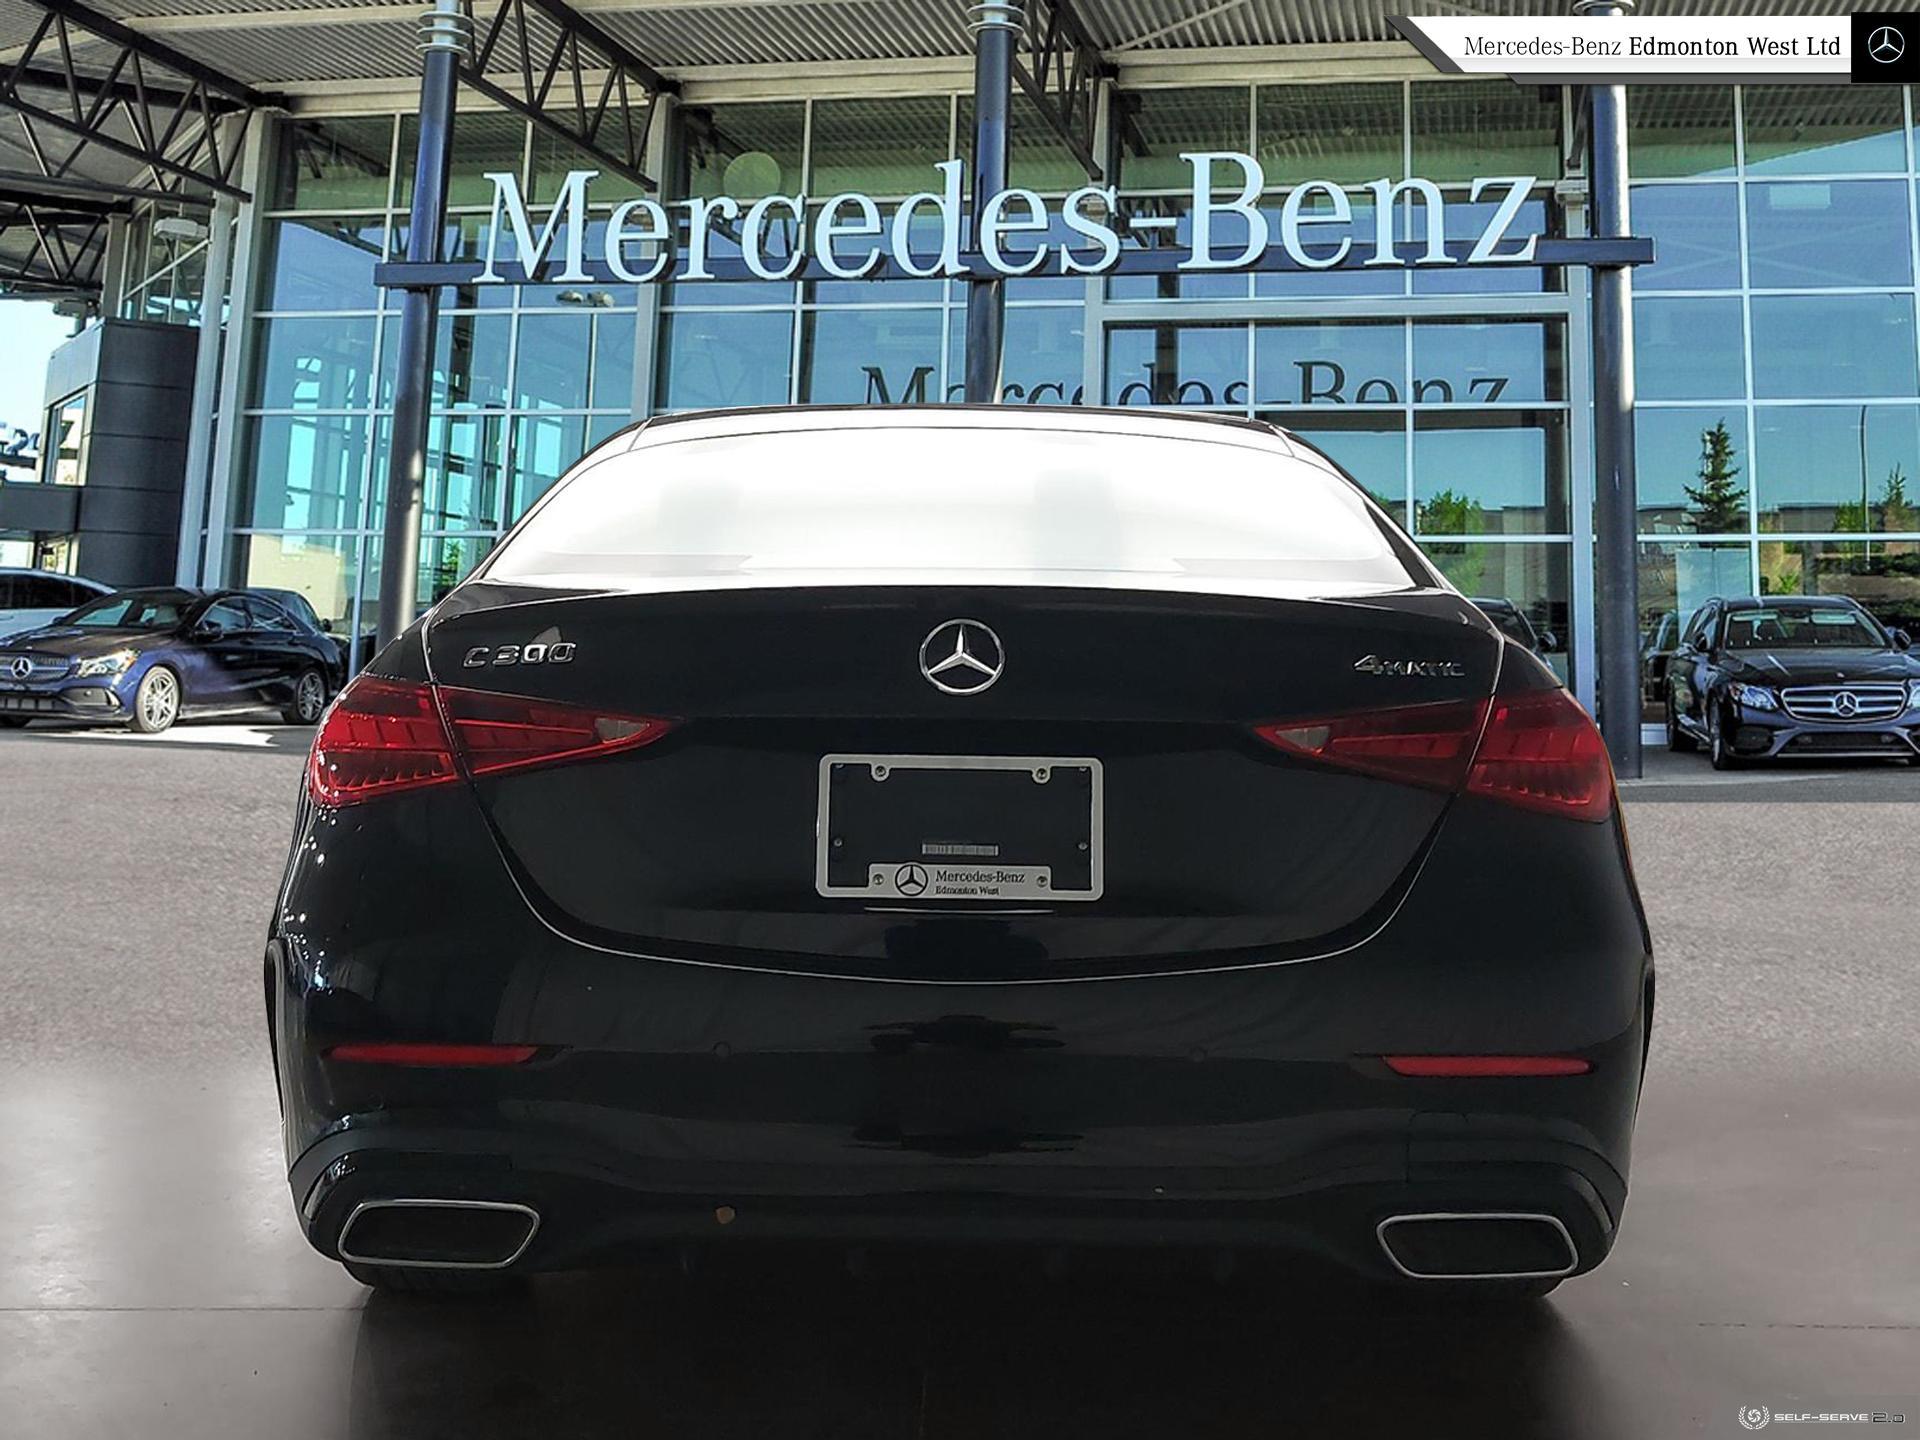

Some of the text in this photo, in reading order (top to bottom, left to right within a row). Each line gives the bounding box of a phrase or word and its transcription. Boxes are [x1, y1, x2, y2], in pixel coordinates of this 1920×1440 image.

[471, 152, 1538, 284] Mercedes-Benz
[861, 361, 1509, 405] Mrcdes-Benz
[935, 870, 1025, 883] Mercedes-Benz
[935, 885, 1000, 896] Edmonton West
